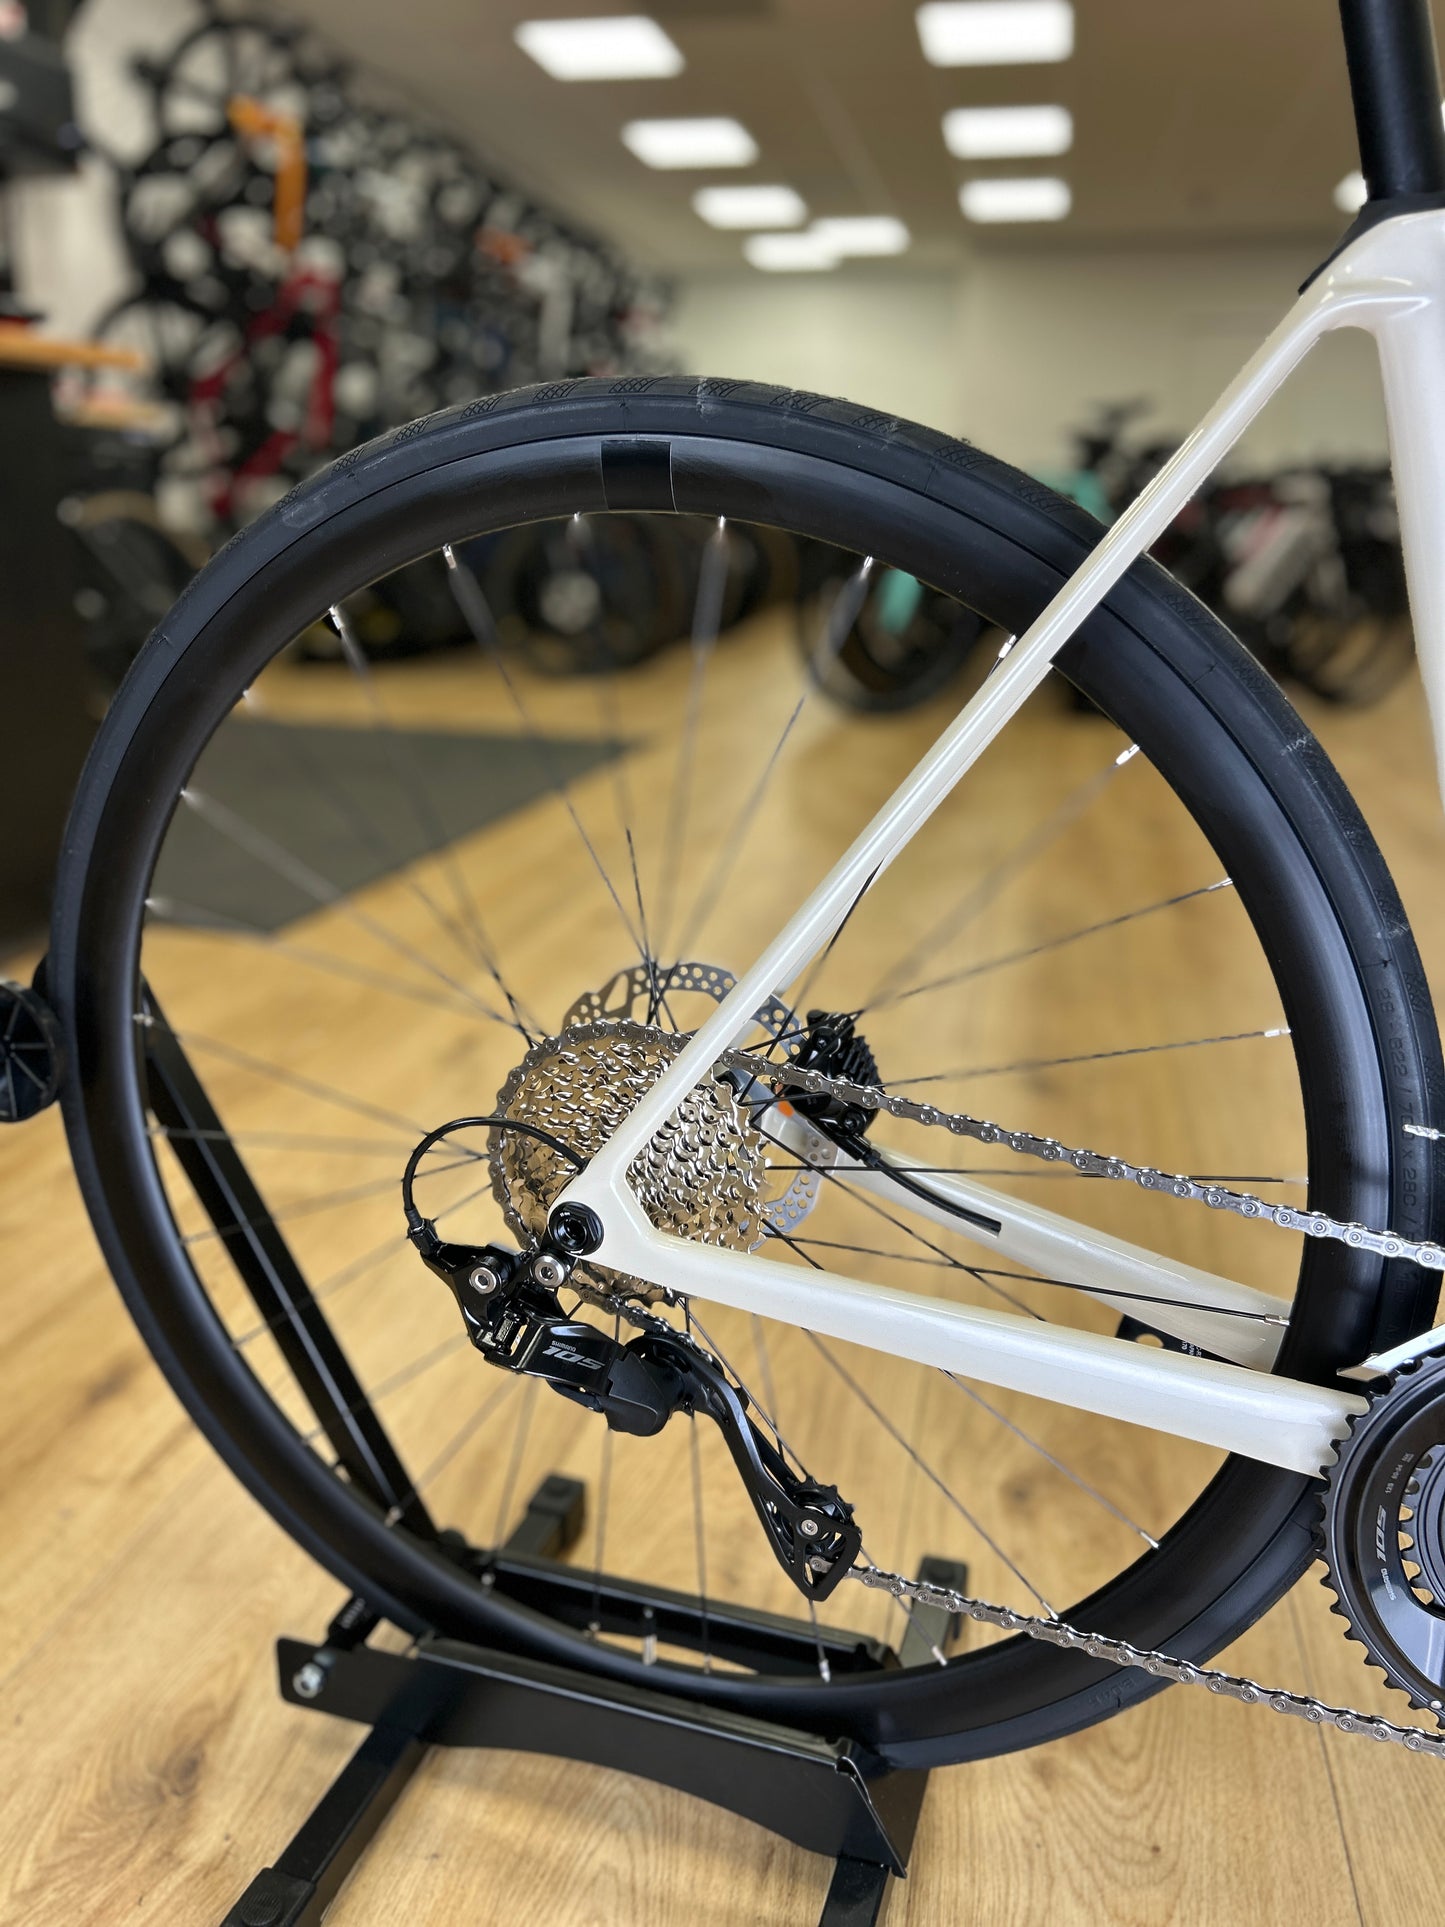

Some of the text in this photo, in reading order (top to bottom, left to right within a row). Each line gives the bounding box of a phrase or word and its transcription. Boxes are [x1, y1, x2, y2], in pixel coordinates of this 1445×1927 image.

[542, 1345, 606, 1370] 105
[551, 1340, 577, 1352] SHIMANO
[1375, 1505, 1396, 1601] SHIMANO 105
